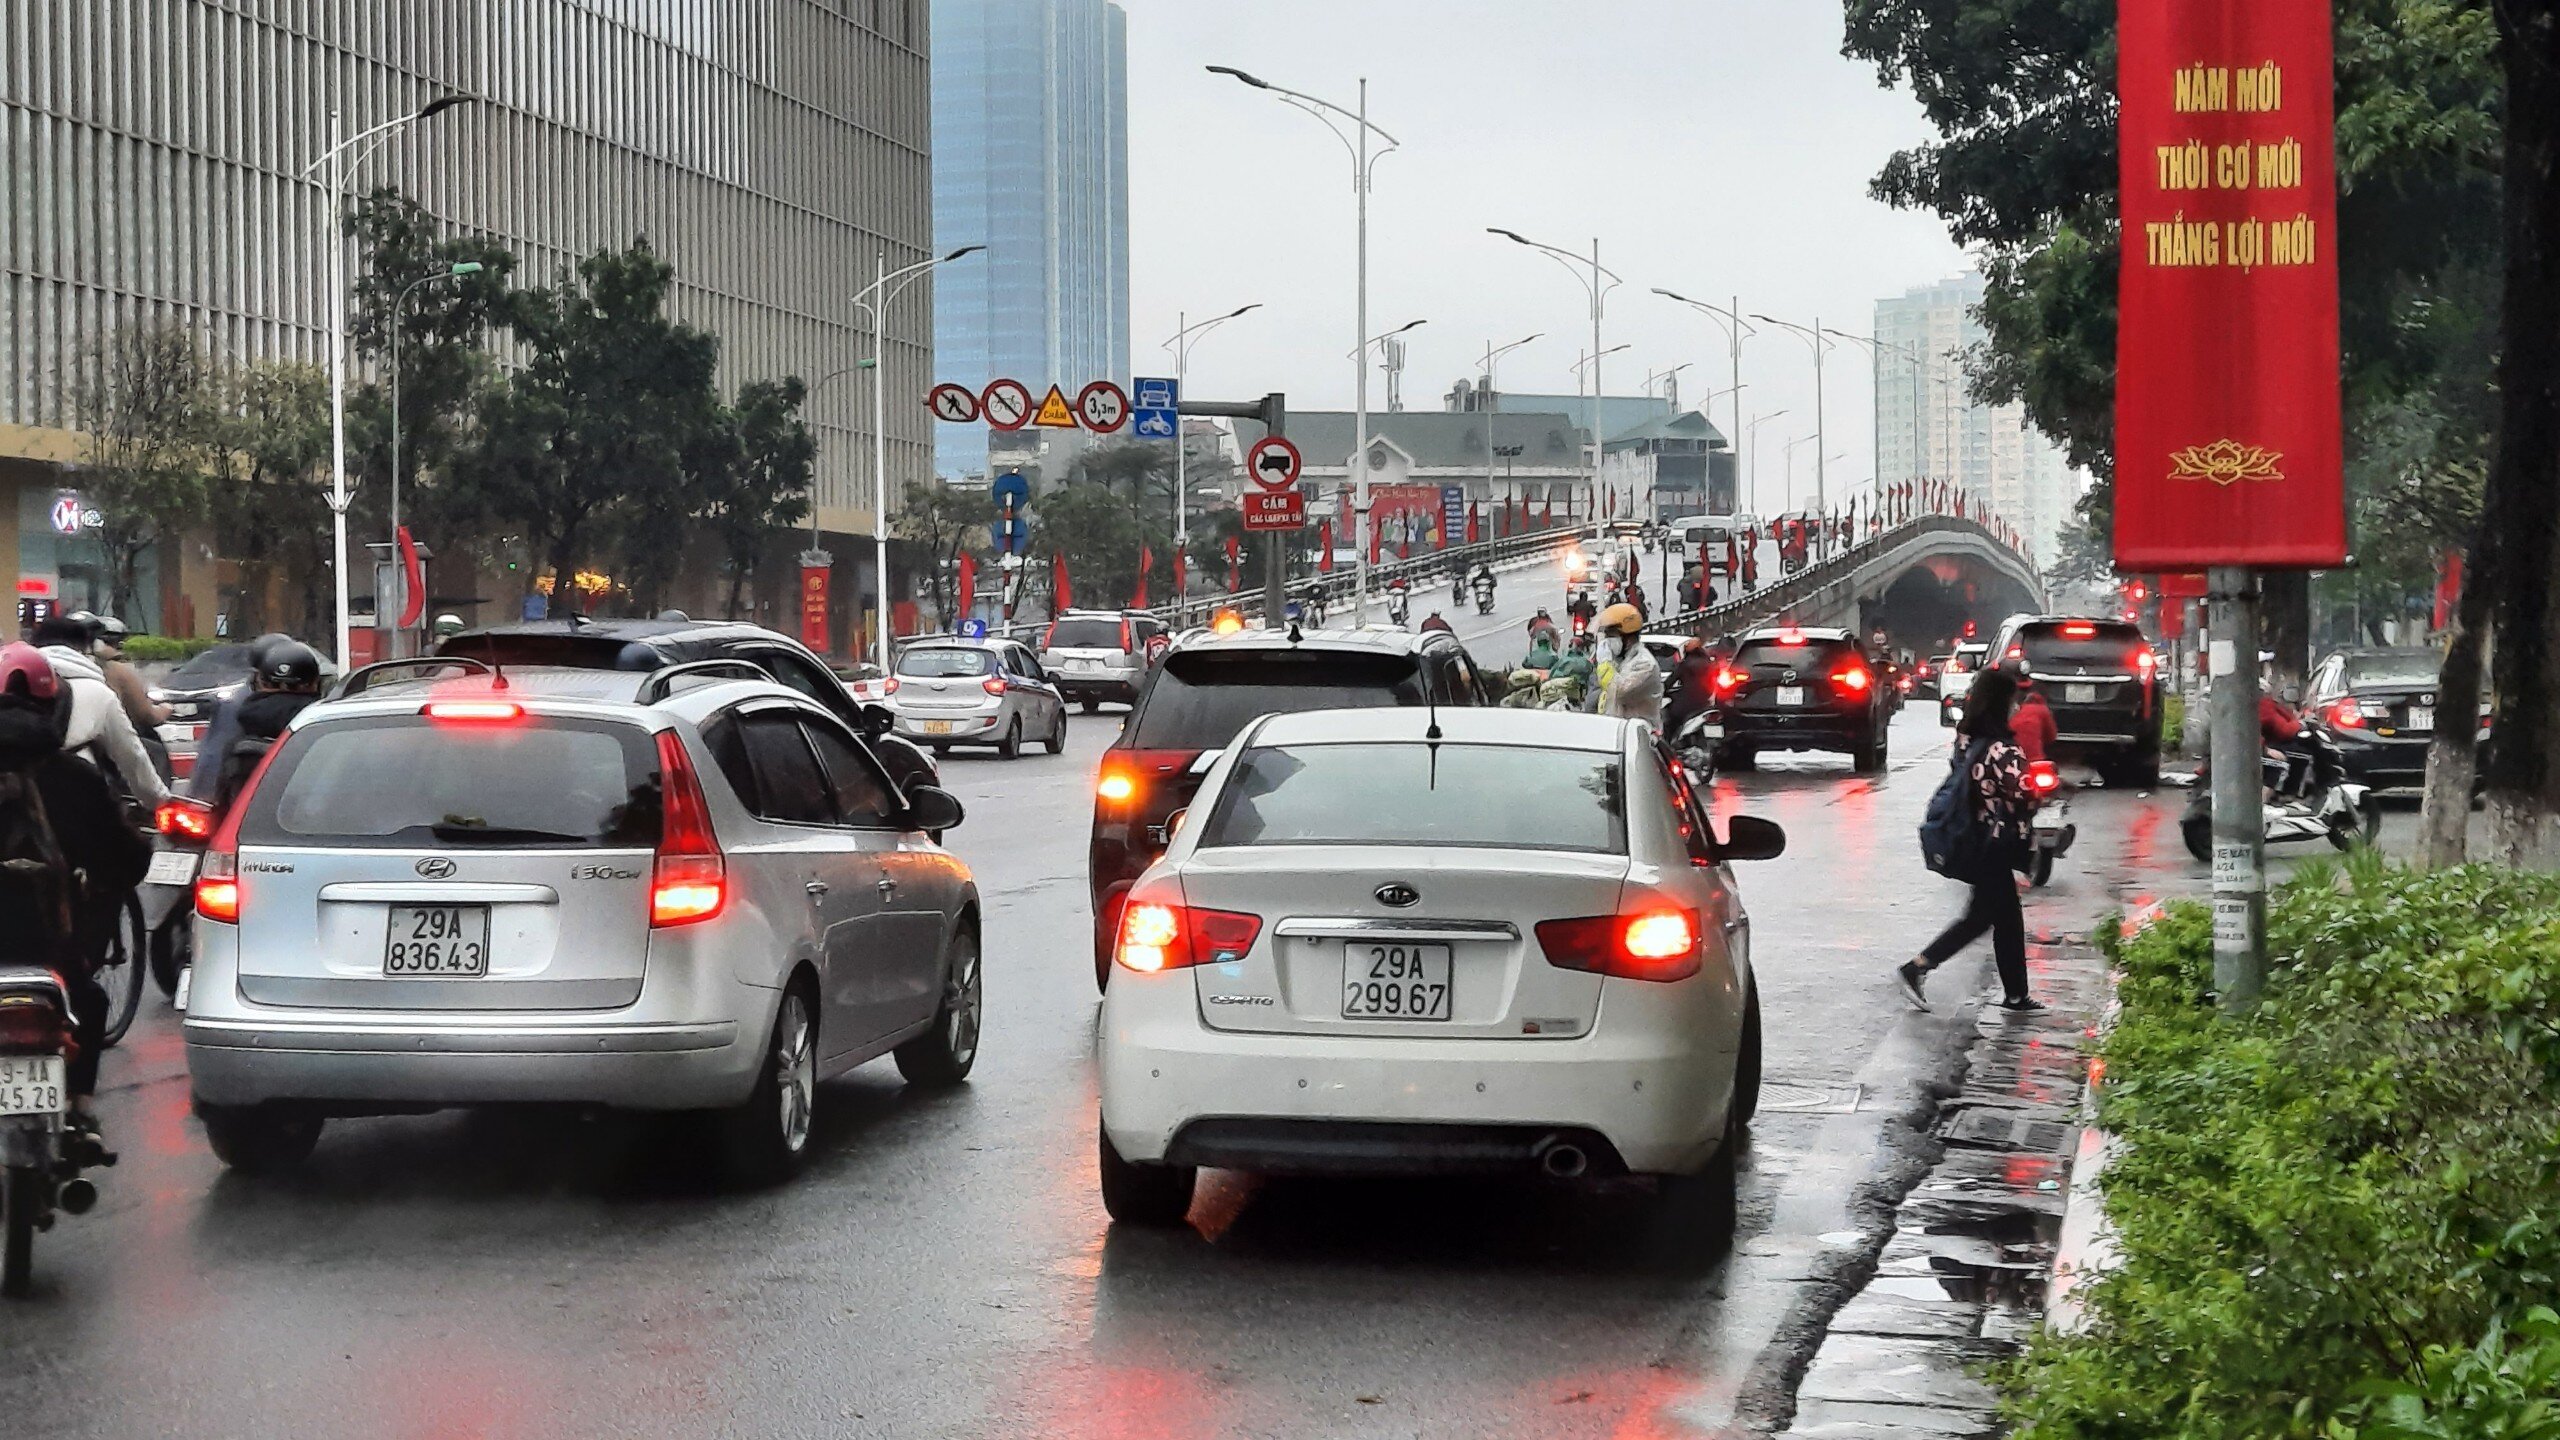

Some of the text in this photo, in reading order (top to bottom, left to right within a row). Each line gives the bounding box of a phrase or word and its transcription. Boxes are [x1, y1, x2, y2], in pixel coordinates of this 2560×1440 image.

[2175, 59, 2281, 112] NĂM MỚI
[2157, 135, 2302, 190] THỜI CƠ MỚI
[2146, 209, 2315, 275] THẮNG LỢI MỚI
[1089, 397, 1116, 418] 3,3m
[1383, 889, 1414, 903] KIA
[412, 909, 462, 939] 29A
[390, 942, 481, 971] 836.43
[1369, 947, 1424, 980] 29A
[1345, 982, 1446, 1016] 299.67
